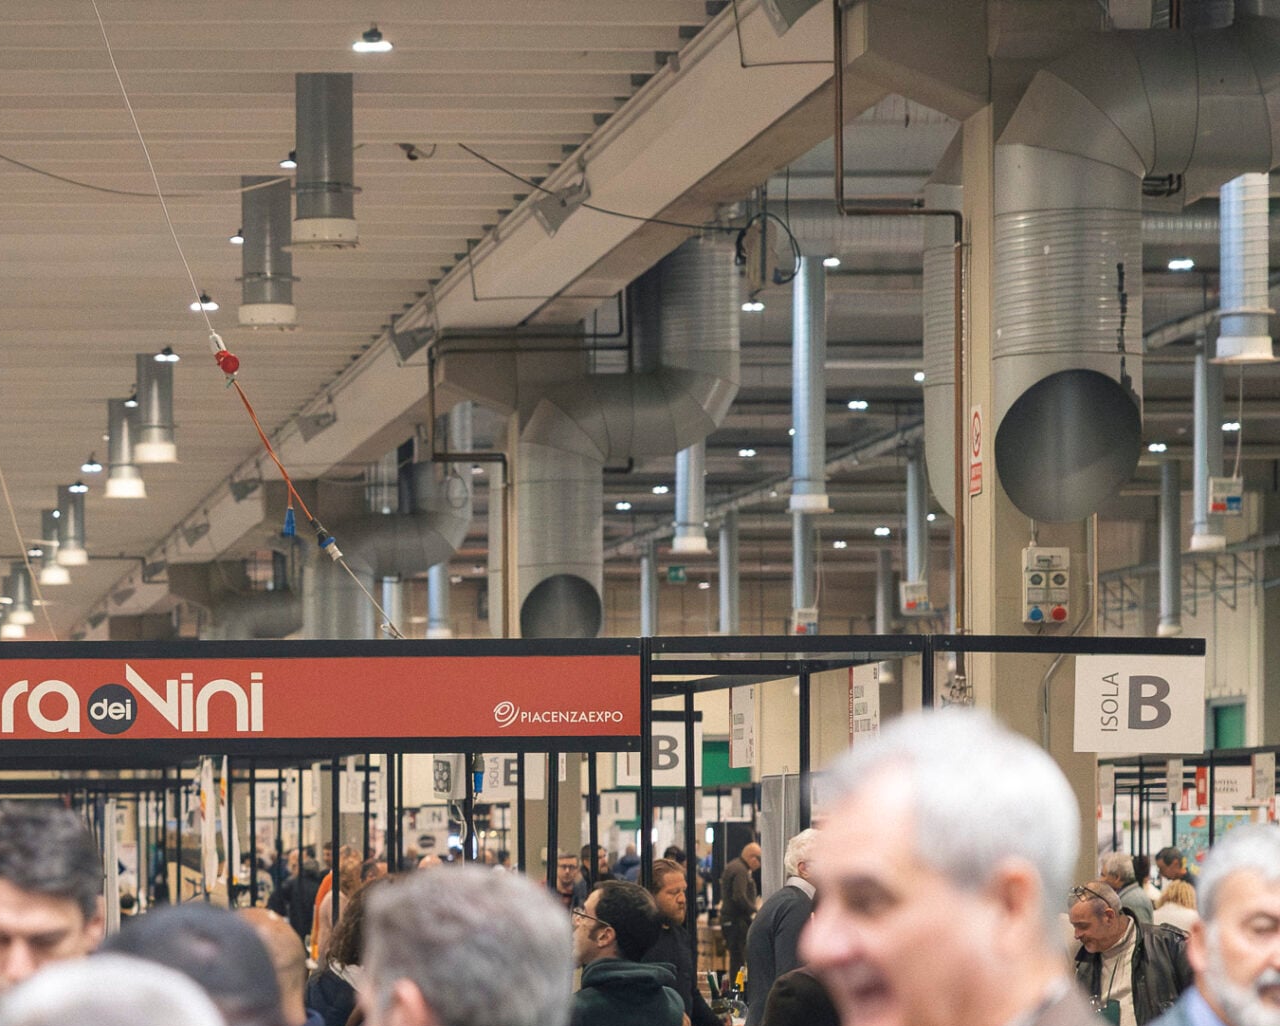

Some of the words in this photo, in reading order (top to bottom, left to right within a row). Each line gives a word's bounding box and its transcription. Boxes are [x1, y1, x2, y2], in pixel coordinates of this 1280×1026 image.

[89, 698, 132, 721] dei
[125, 663, 263, 732] Vini
[520, 710, 624, 723] PIACENZAEXPO
[1101, 672, 1119, 732] ISOLA
[1127, 675, 1172, 730] B
[652, 735, 680, 771] B
